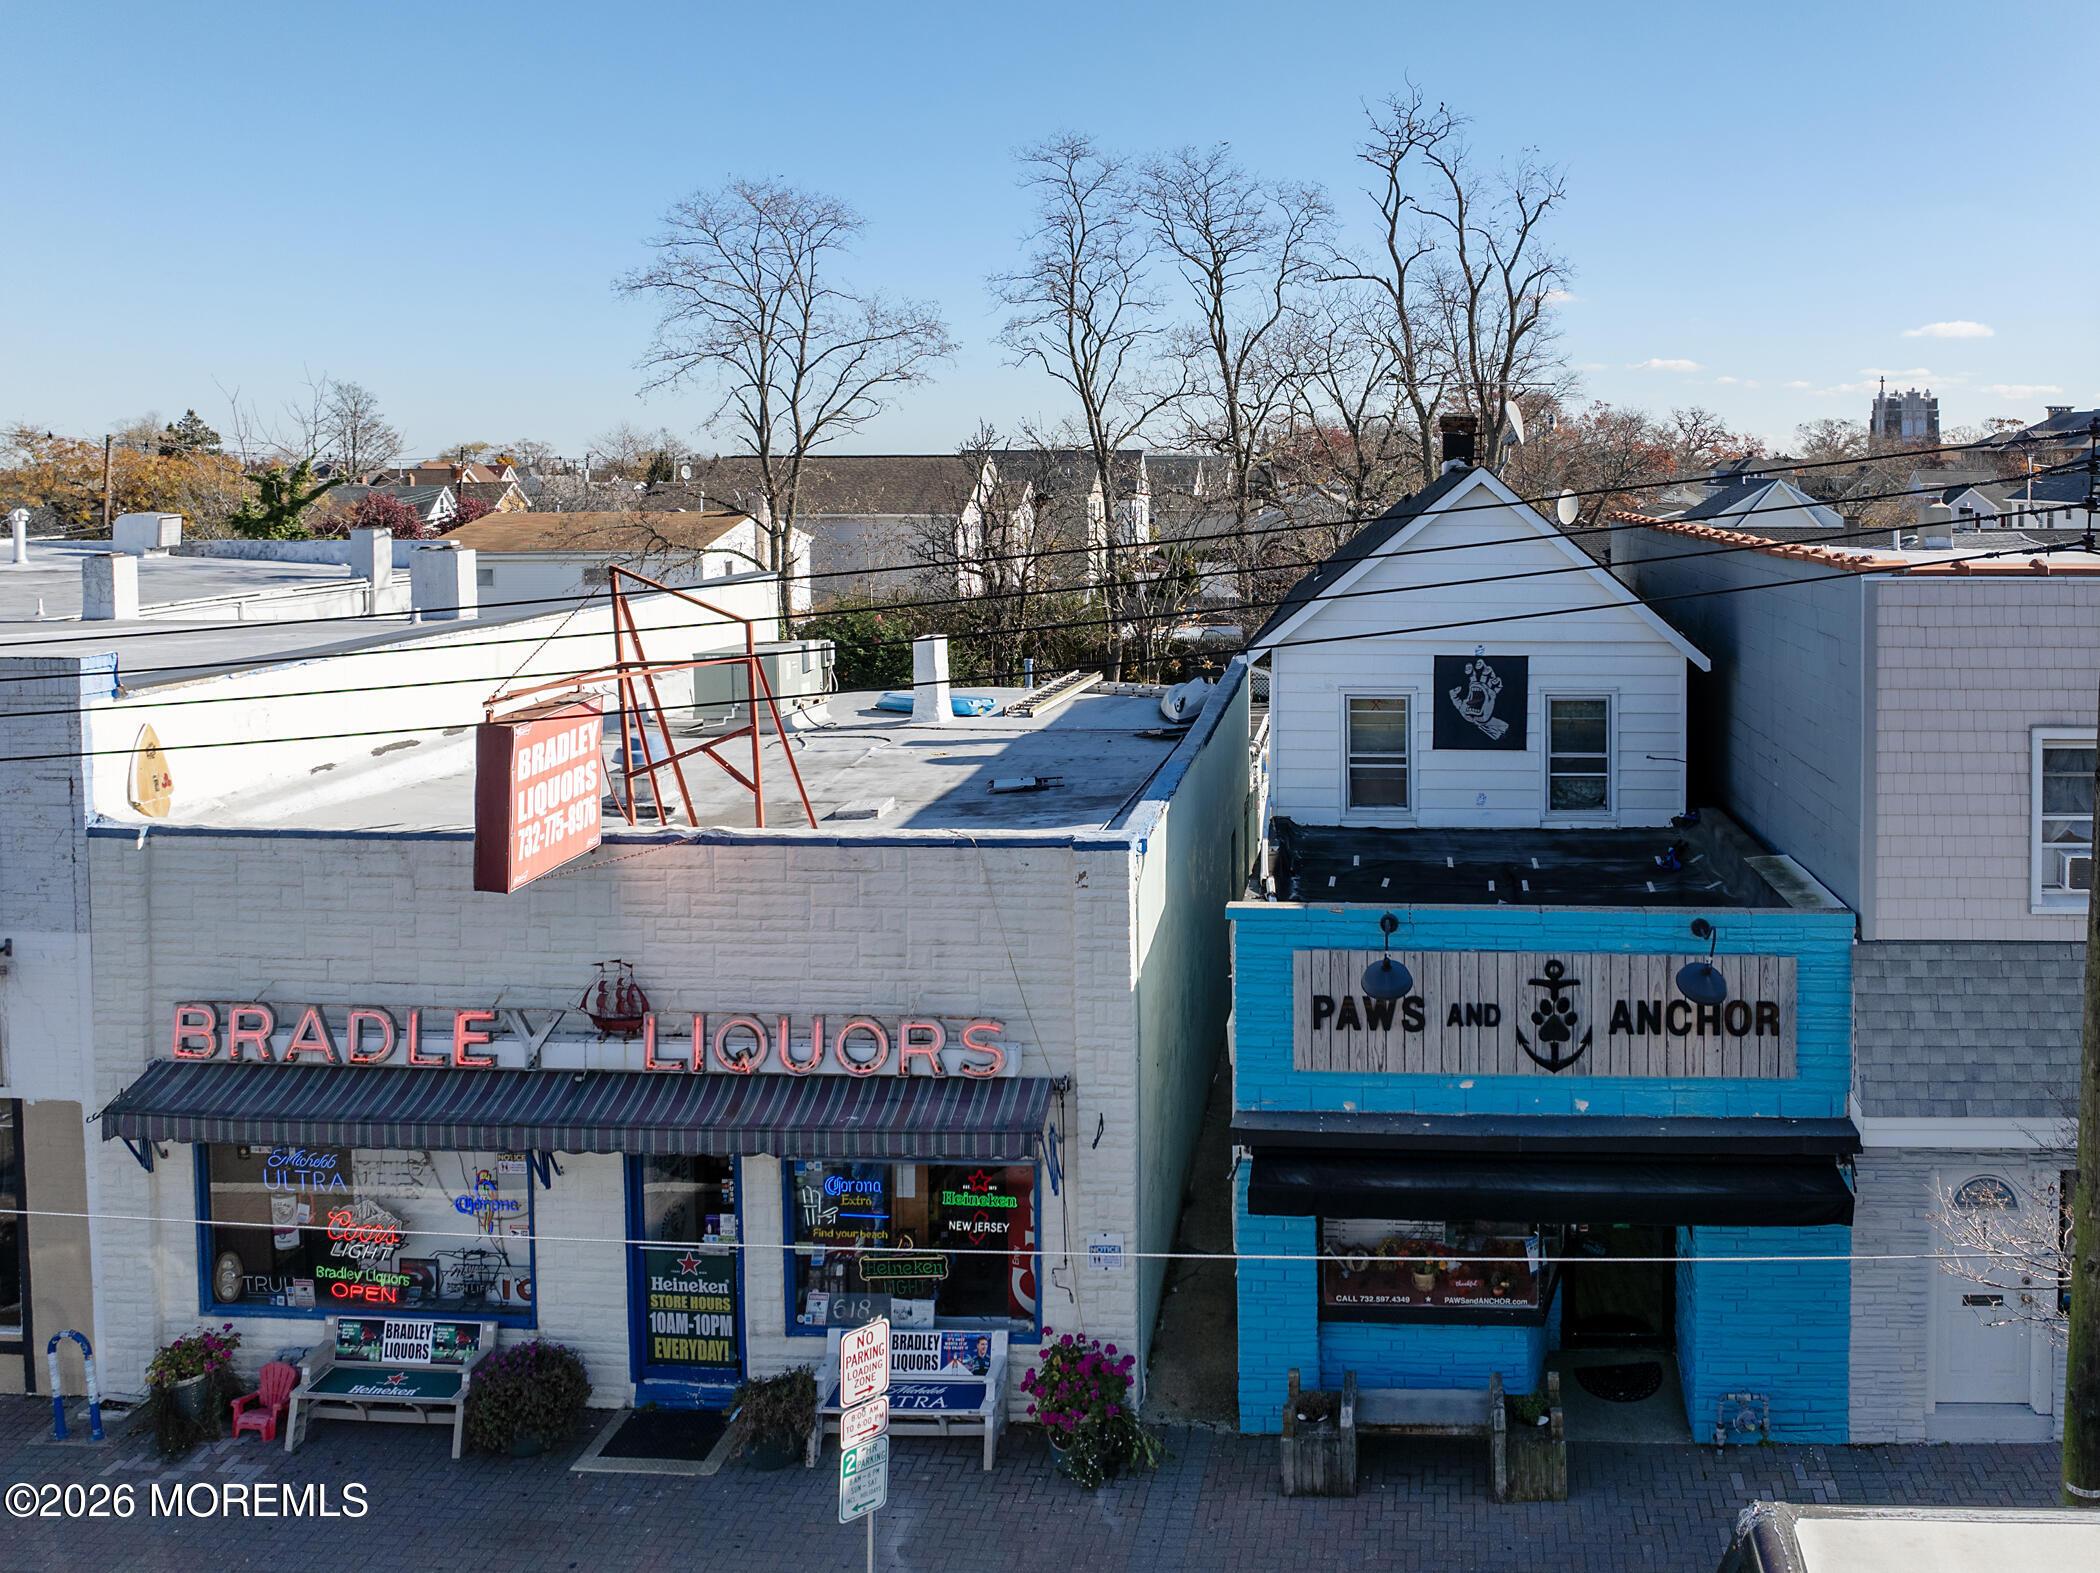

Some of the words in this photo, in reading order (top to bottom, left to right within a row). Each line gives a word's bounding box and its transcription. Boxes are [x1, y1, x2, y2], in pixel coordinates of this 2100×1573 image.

[518, 719, 600, 782] BRADLEY
[518, 760, 597, 824] LIQUORS
[518, 795, 597, 861] 732-775-8976
[1312, 995, 1426, 1032] PAWS
[1446, 1001, 1500, 1028] AND
[1609, 999, 1778, 1037] ANCHOR
[173, 1001, 566, 1071] BRADLEY
[643, 1011, 1006, 1079] LIQUORS
[263, 1168, 347, 1192] ULTRA
[824, 1176, 882, 1196] Corona
[455, 1195, 520, 1216] Corona
[840, 1194, 872, 1206] Extra
[942, 1190, 1017, 1208] Heineken
[327, 1211, 399, 1245] Coors
[813, 1228, 834, 1237] Find
[835, 1230, 859, 1239] your
[861, 1230, 888, 1239] beach
[949, 1220, 972, 1231] NEW
[973, 1221, 1010, 1233] JERSEY
[330, 1242, 394, 1260] LIGHT
[316, 1265, 362, 1283] Bradley
[366, 1268, 410, 1287] Liquors
[866, 1260, 944, 1276] Heineken
[331, 1282, 396, 1303] OPEN
[651, 1276, 728, 1294] Heineken
[650, 1294, 688, 1309] STORE
[690, 1296, 731, 1311] HOURS
[833, 1299, 871, 1319] 618
[1336, 1295, 1358, 1303] CALL
[1360, 1295, 1410, 1303] 732.597.4349
[1444, 1297, 1528, 1305] PAWSandANCHOR.com
[386, 1323, 432, 1341] BRADLEY
[649, 1311, 733, 1336] 10AM-10PM
[654, 1337, 729, 1361] EVERYDAY!
[857, 1331, 874, 1349] NO
[892, 1334, 940, 1351] BRADLEY
[384, 1342, 429, 1359] LIQUORS
[846, 1342, 885, 1370] PARKING
[847, 1360, 883, 1381] LOADING
[891, 1354, 939, 1372] LIQUORS
[854, 1372, 877, 1389] ZONE
[348, 1385, 417, 1396] Heineken
[846, 1425, 854, 1434] TO
[857, 1418, 872, 1430] 6:00
[875, 1412, 884, 1421] PM
[851, 1410, 866, 1422] 8:00
[869, 1405, 879, 1415] AM
[845, 1454, 856, 1474] 2
[866, 1443, 878, 1457] HR
[857, 1450, 886, 1469] PARKING
